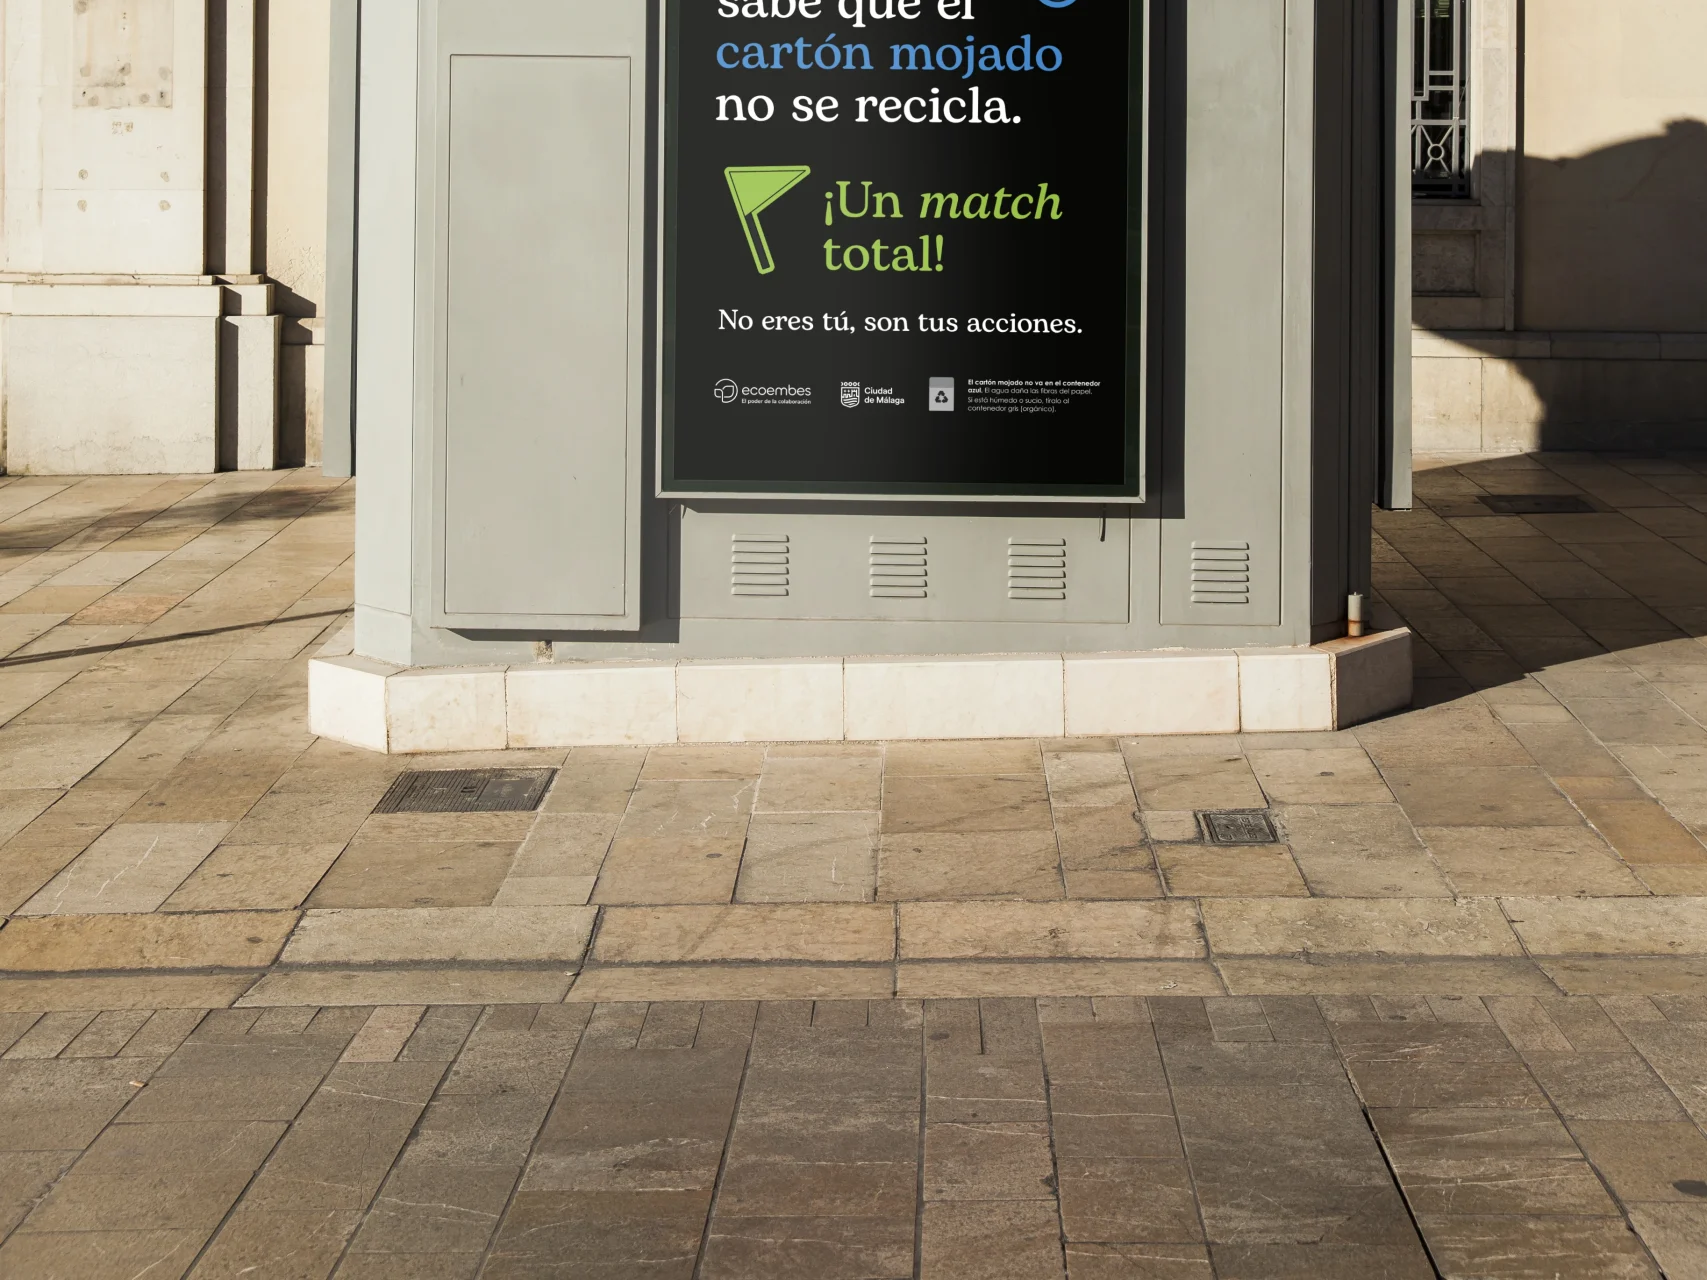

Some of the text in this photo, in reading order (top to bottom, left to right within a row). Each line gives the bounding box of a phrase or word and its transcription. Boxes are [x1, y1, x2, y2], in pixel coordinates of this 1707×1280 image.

[716, 32, 1063, 80] cartón mojado
[715, 85, 1022, 124] no se recicla.
[824, 180, 1063, 227] ¡Un match
[823, 234, 944, 272] total!
[718, 308, 1083, 334] No eres tú, son tus acciones.
[998, 379, 1023, 387] mojado
[741, 384, 812, 397] ecoembes
[864, 386, 893, 395] Ciudad
[1071, 388, 1093, 396] papel.
[864, 395, 905, 406] de Málaga
[1025, 397, 1044, 405] sucio,
